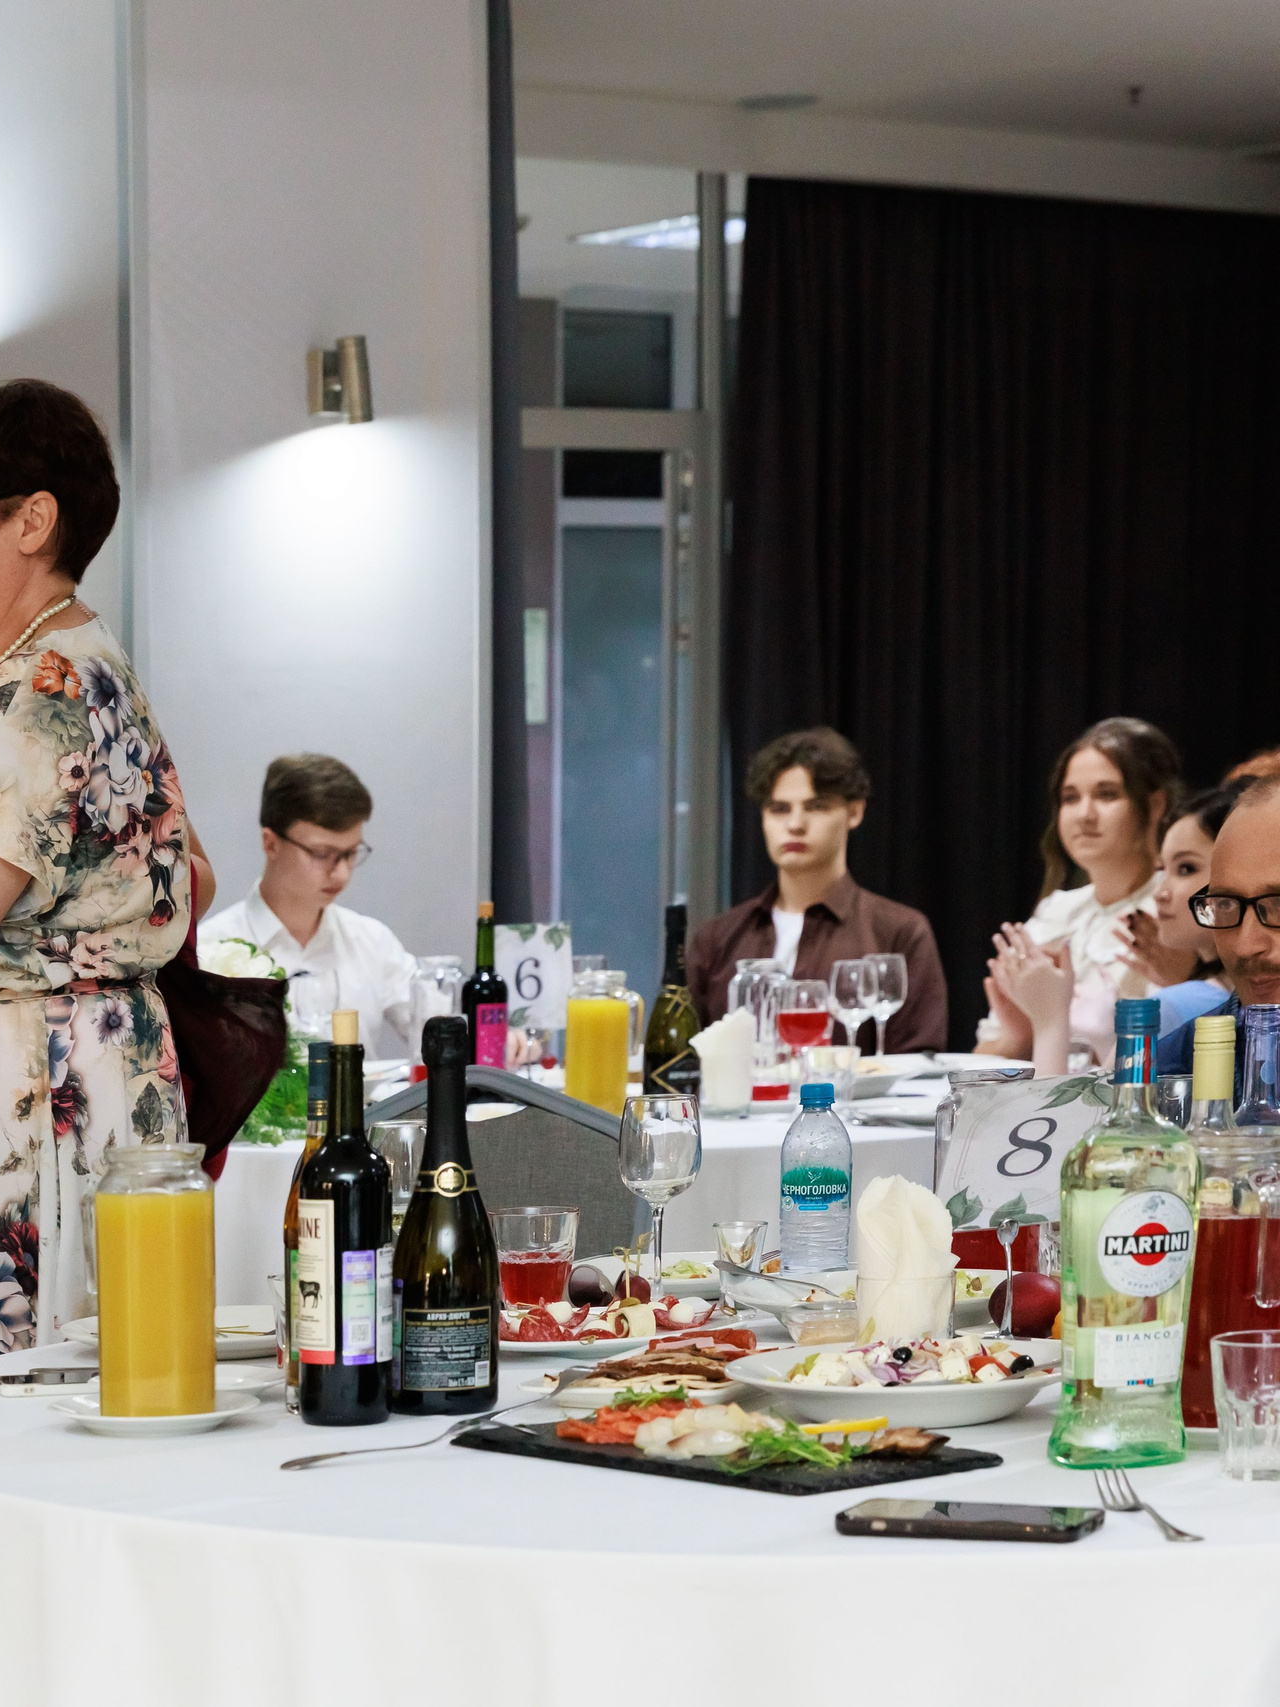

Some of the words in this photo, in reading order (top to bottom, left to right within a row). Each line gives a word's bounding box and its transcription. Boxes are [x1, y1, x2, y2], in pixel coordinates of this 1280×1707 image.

[515, 956, 543, 1001] 6
[996, 1116, 1058, 1177] 8
[1106, 1232, 1188, 1255] MARTINI
[1115, 1330, 1171, 1342] BIANCO
